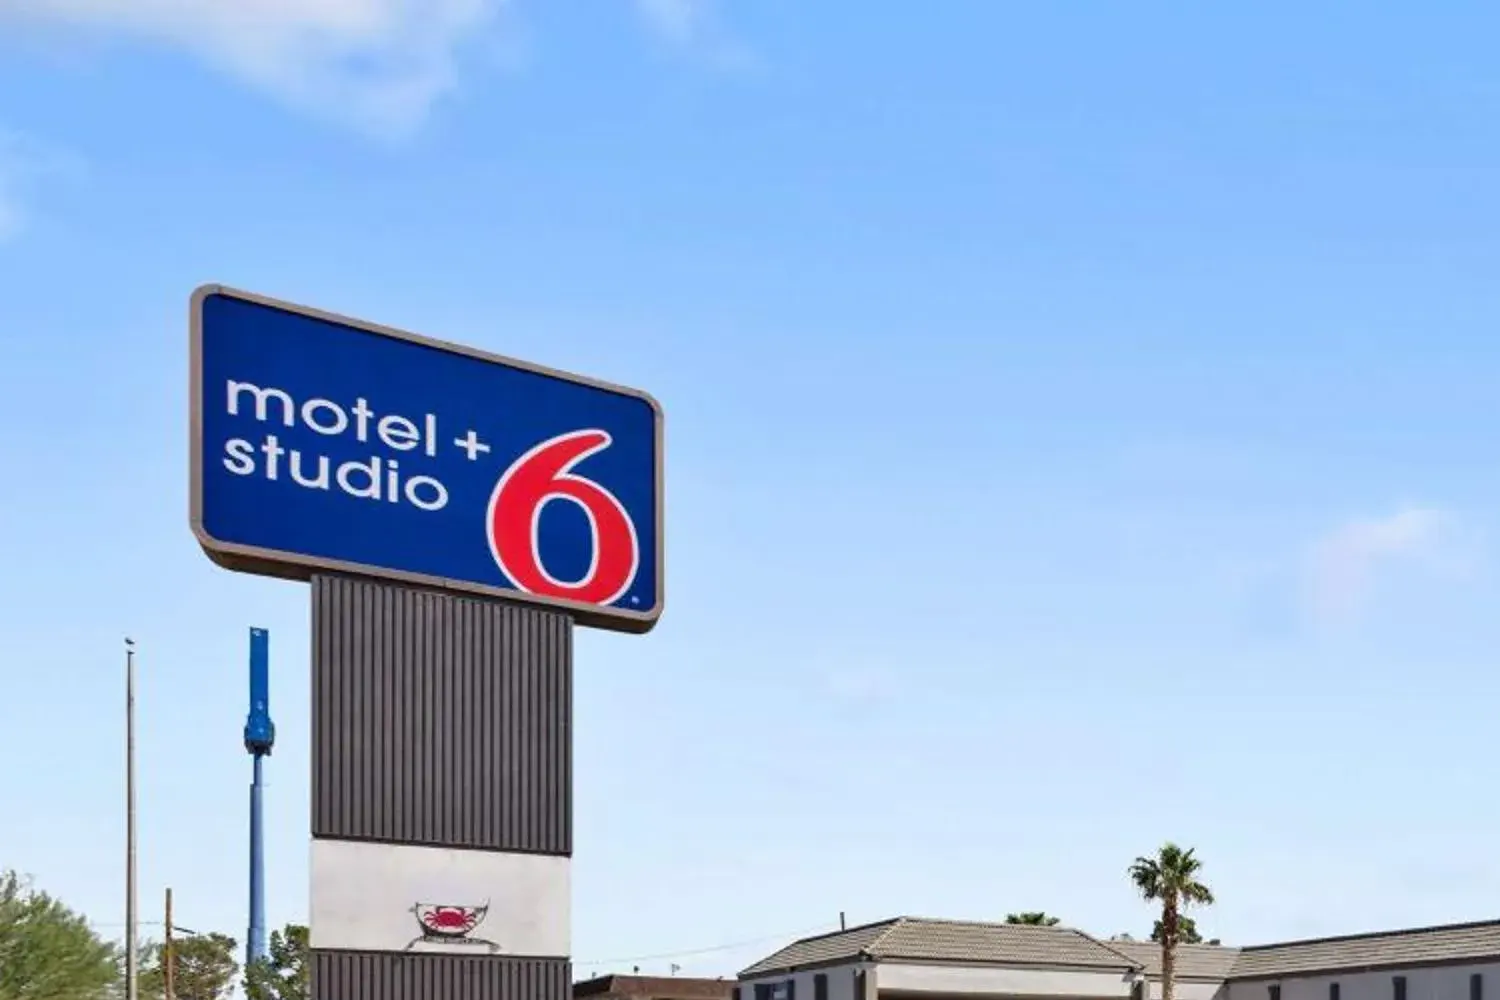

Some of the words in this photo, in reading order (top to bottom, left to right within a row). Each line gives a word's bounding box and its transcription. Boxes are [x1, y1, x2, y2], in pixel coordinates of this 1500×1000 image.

[226, 379, 437, 457] motel
[222, 435, 450, 511] studio
[486, 428, 640, 606] 6
